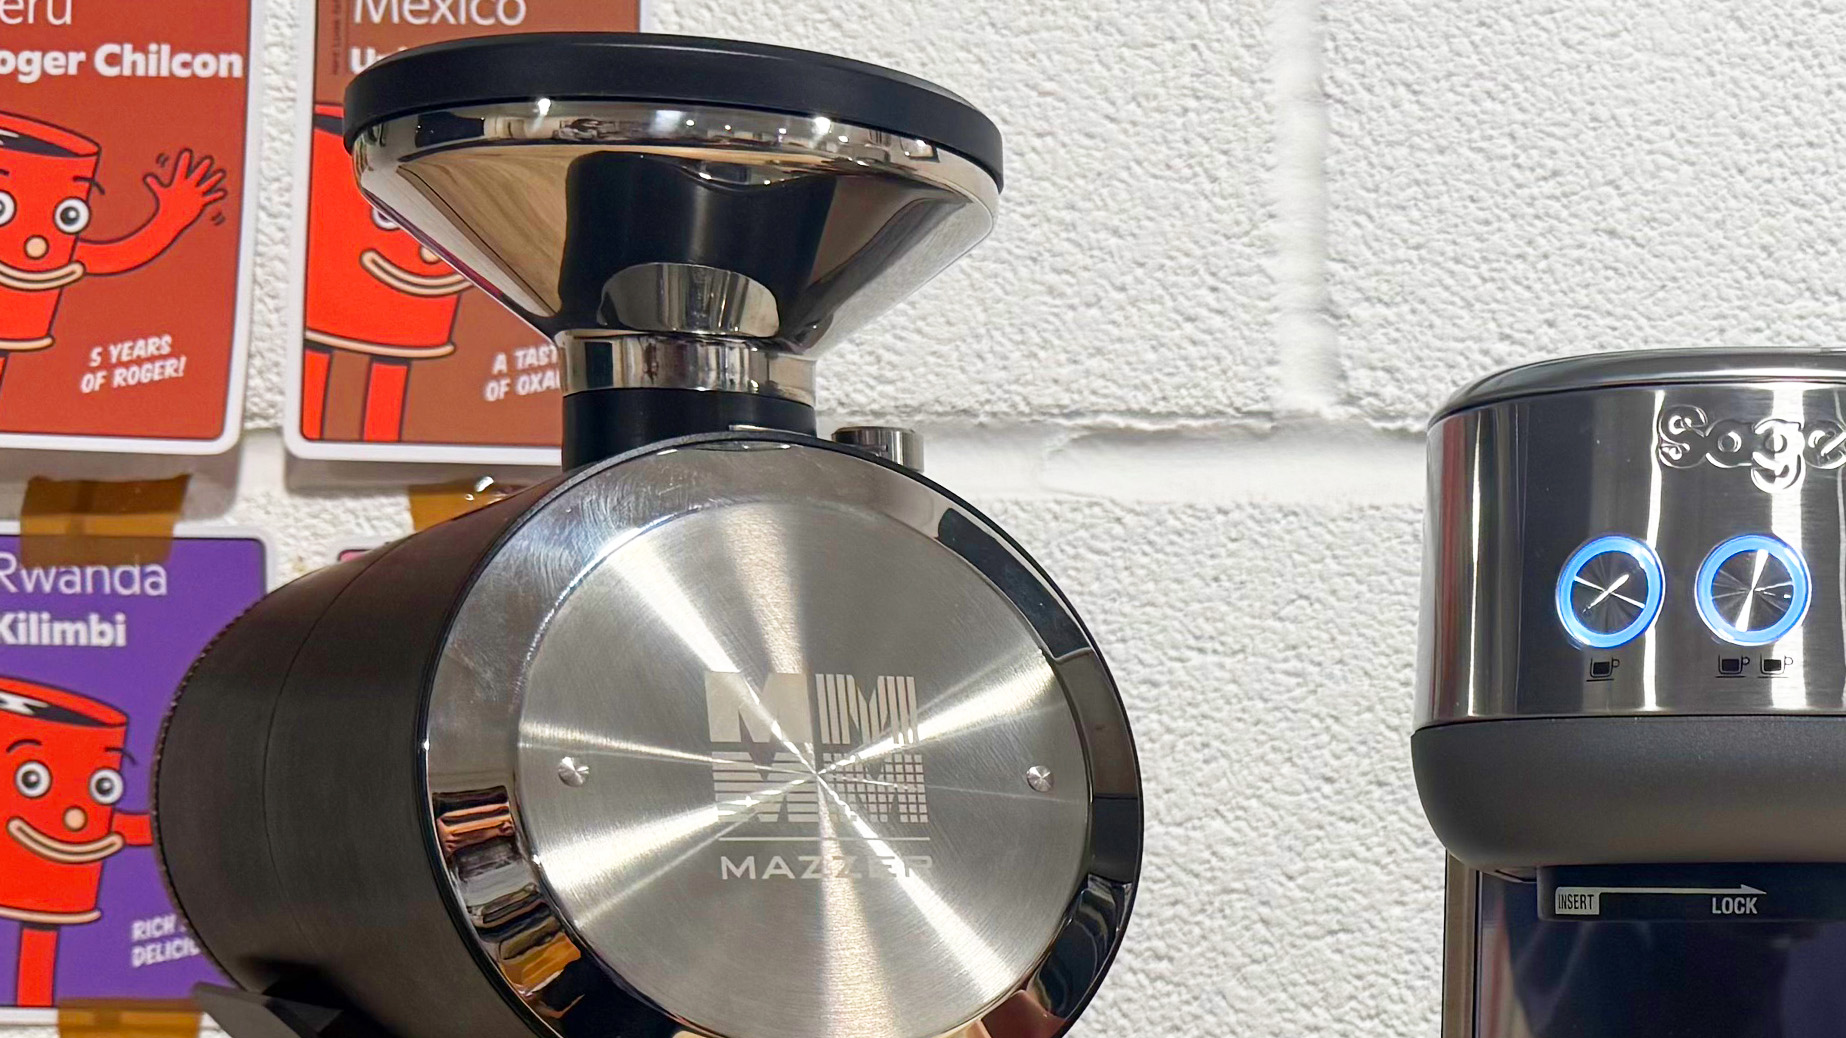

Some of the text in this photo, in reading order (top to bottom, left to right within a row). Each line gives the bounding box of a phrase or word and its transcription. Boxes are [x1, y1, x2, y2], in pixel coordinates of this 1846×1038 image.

[353, 0, 527, 26] Mexico
[94, 43, 243, 78] Chilcon
[109, 334, 172, 364] YEARS
[492, 352, 507, 375] A
[80, 354, 187, 394] OF ROGER!
[484, 367, 560, 402] OF OXA
[0, 551, 168, 596] Rwanda
[0, 611, 127, 647] Kilimbi
[1558, 894, 1595, 910] INSERT
[1712, 897, 1758, 915] LOCK
[131, 914, 177, 942] RICH
